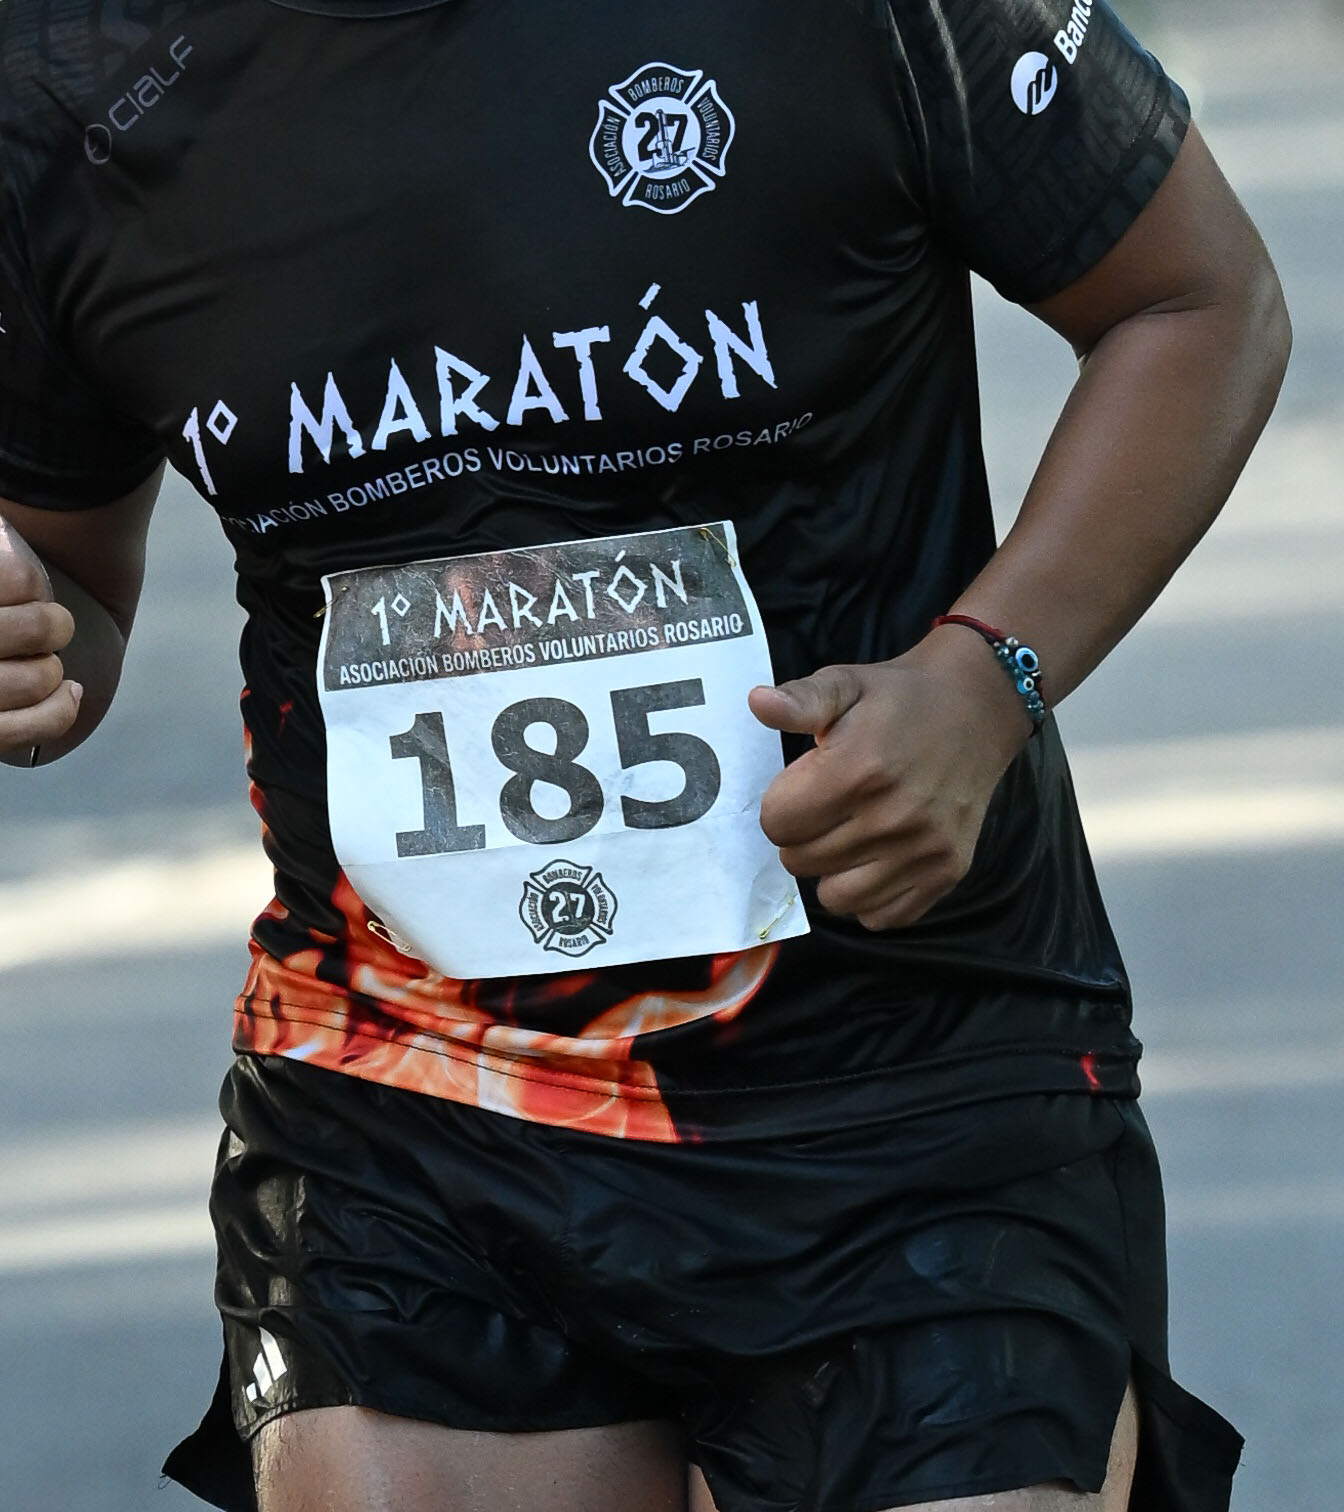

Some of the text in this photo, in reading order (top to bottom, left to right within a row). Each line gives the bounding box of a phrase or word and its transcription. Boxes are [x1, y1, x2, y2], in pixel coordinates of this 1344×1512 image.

[627, 76, 684, 101] BOMBEROS
[603, 115, 626, 177] ASOCIACIÓN
[634, 112, 688, 162] 27
[696, 97, 721, 161] VOLUNTARIOS
[645, 178, 691, 201] ROSARIO
[288, 283, 778, 474] MARATÓN
[327, 448, 481, 513] BOMBEROS
[486, 442, 683, 475] VOLUNTARIOS
[693, 412, 813, 455] ROSARIO
[434, 549, 688, 639] MARATÓN
[340, 613, 743, 686] ASOCIACIÓN BOMBEROS VOLUNTARIOS ROSARIO
[389, 678, 721, 858] 185
[549, 891, 586, 924] 27
